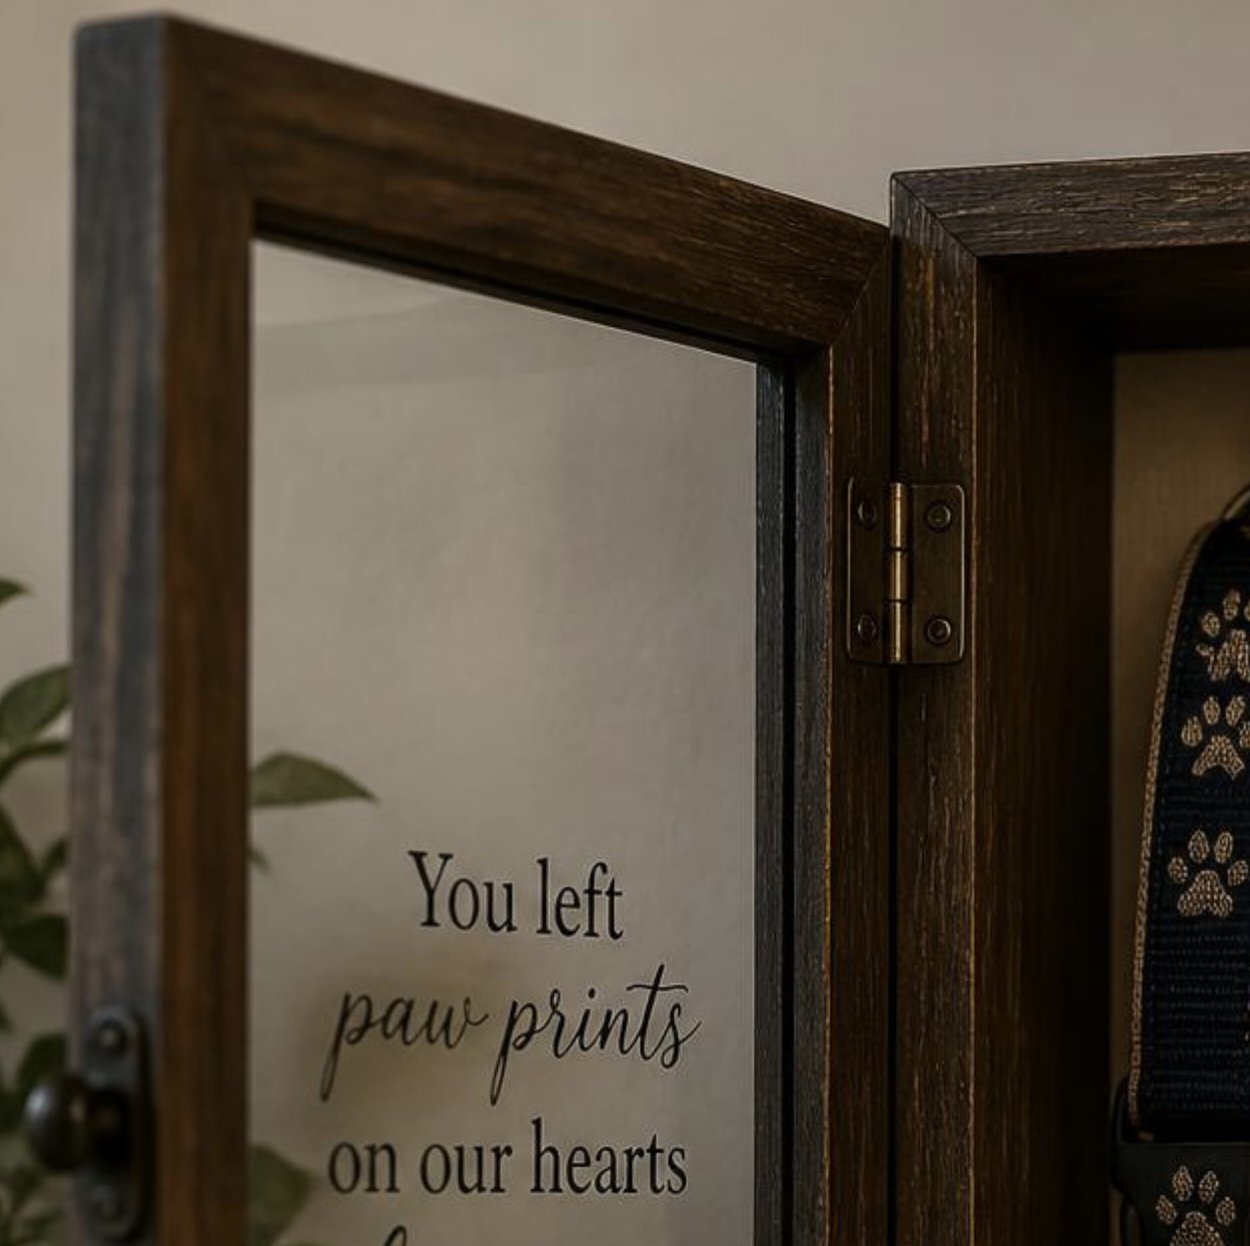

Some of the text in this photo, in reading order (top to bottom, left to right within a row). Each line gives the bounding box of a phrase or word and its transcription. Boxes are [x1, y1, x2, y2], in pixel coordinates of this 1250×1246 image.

[408, 850, 624, 940] You left
[320, 963, 702, 1107] paw prints
[328, 1117, 689, 1195] on our hearts
